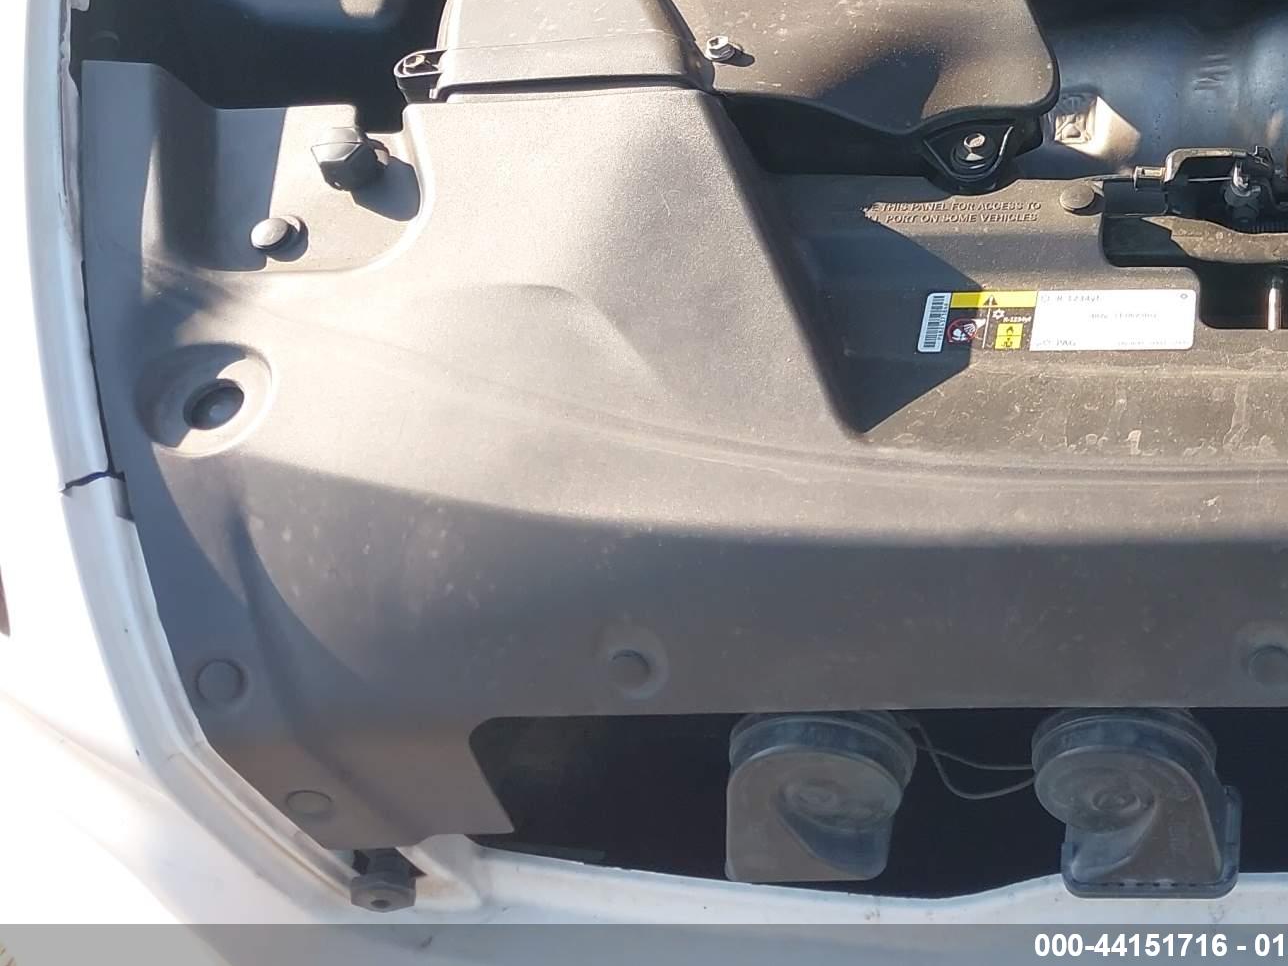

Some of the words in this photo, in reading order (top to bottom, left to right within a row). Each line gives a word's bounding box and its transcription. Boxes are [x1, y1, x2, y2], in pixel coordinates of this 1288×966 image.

[881, 202, 908, 212] THIS
[911, 202, 948, 212] PANEL
[951, 202, 975, 211] FOR
[978, 202, 1023, 211] ACCESS
[1027, 202, 1042, 211] TO
[886, 214, 918, 223] PORT
[922, 214, 939, 223] ON
[981, 213, 1038, 222] VEHICLES
